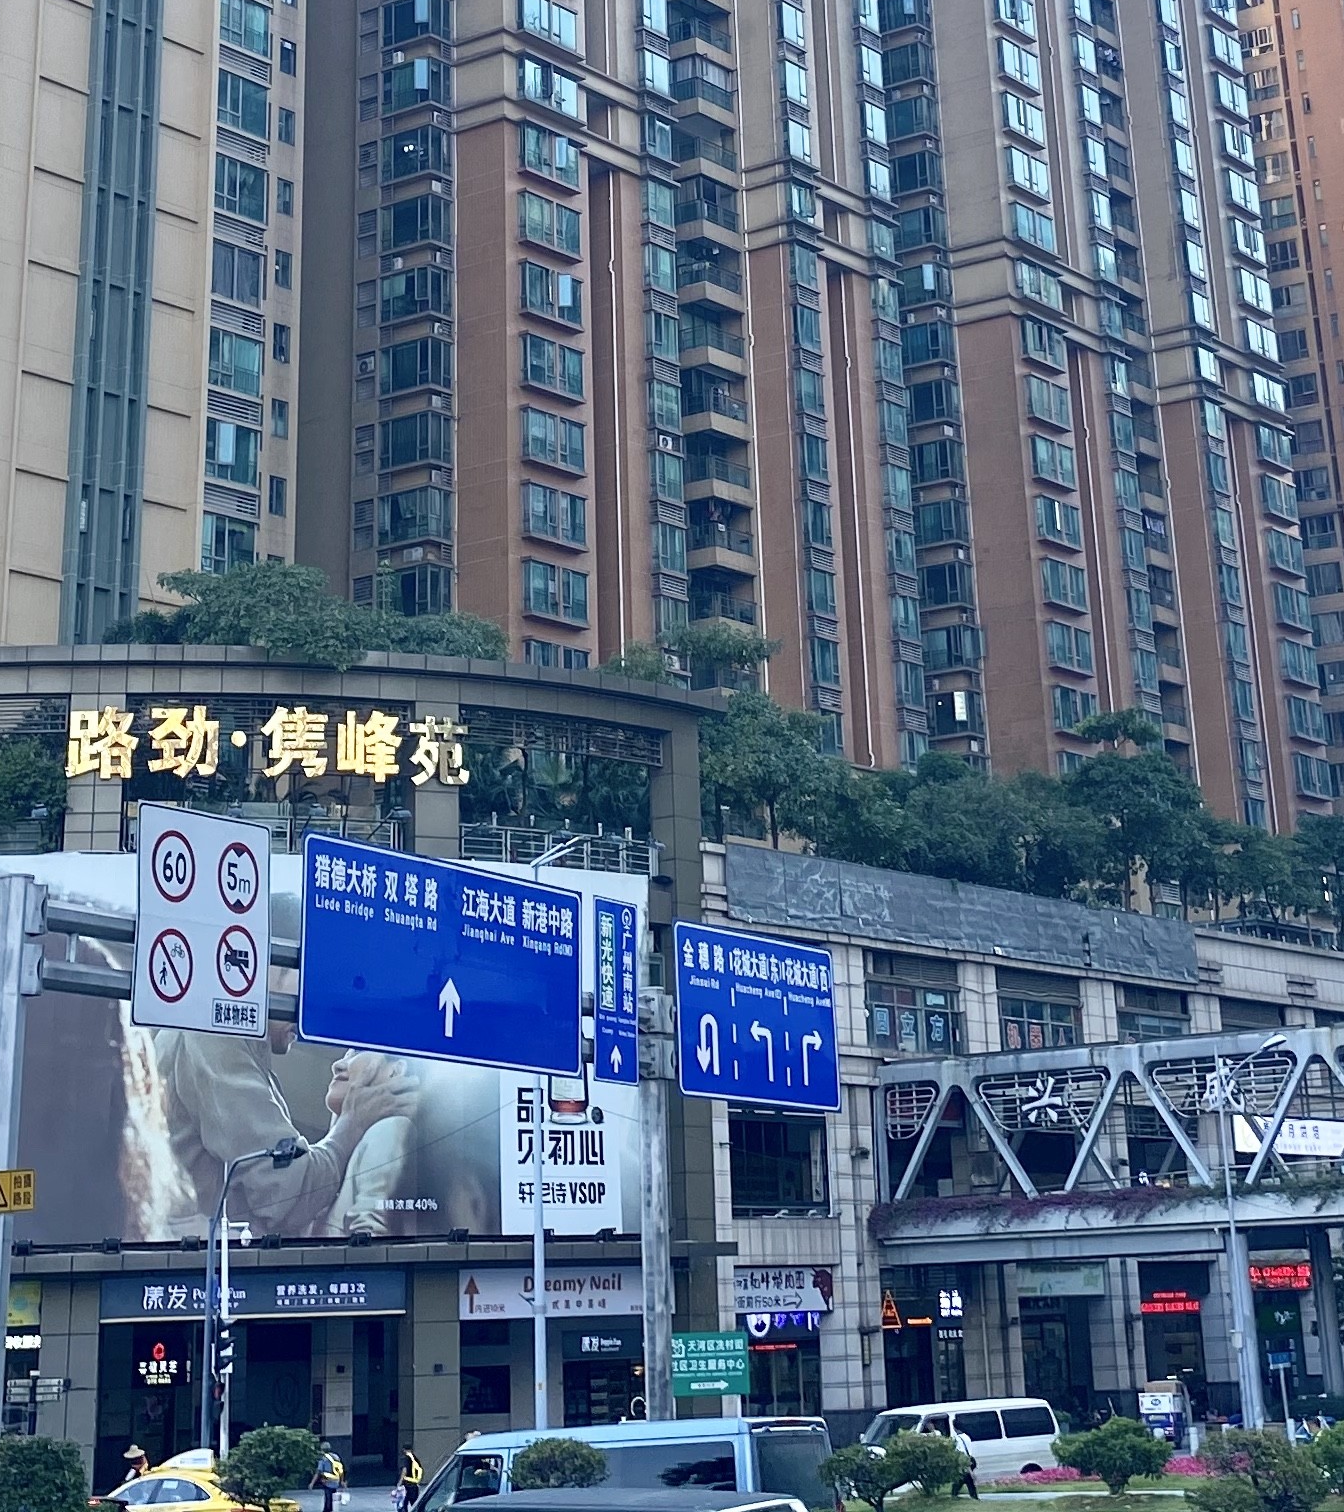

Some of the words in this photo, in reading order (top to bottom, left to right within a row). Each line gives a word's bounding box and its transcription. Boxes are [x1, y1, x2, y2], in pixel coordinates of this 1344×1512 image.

[162, 850, 187, 885] 60
[226, 861, 251, 895] 5m
[314, 854, 378, 899] 猎德大桥
[383, 870, 439, 913] 双塔路
[461, 886, 516, 928] 江海大道
[521, 899, 574, 940] 新港中路
[314, 893, 341, 912] Liede
[344, 901, 375, 922] Bridge
[384, 908, 425, 932] Shuangta
[426, 917, 438, 932] Rd
[461, 924, 498, 944] Jianghai
[500, 931, 516, 947] Ave
[522, 935, 552, 956] Xingang
[599, 914, 615, 1008] 新光快速
[621, 930, 634, 1014] 广州南站
[214, 1002, 257, 1026] 散体物料车
[374, 1197, 438, 1212] 酒精浓度40%
[568, 1181, 606, 1205] VSOP
[523, 1275, 587, 1294] Deamy
[589, 1273, 622, 1292] Nail
